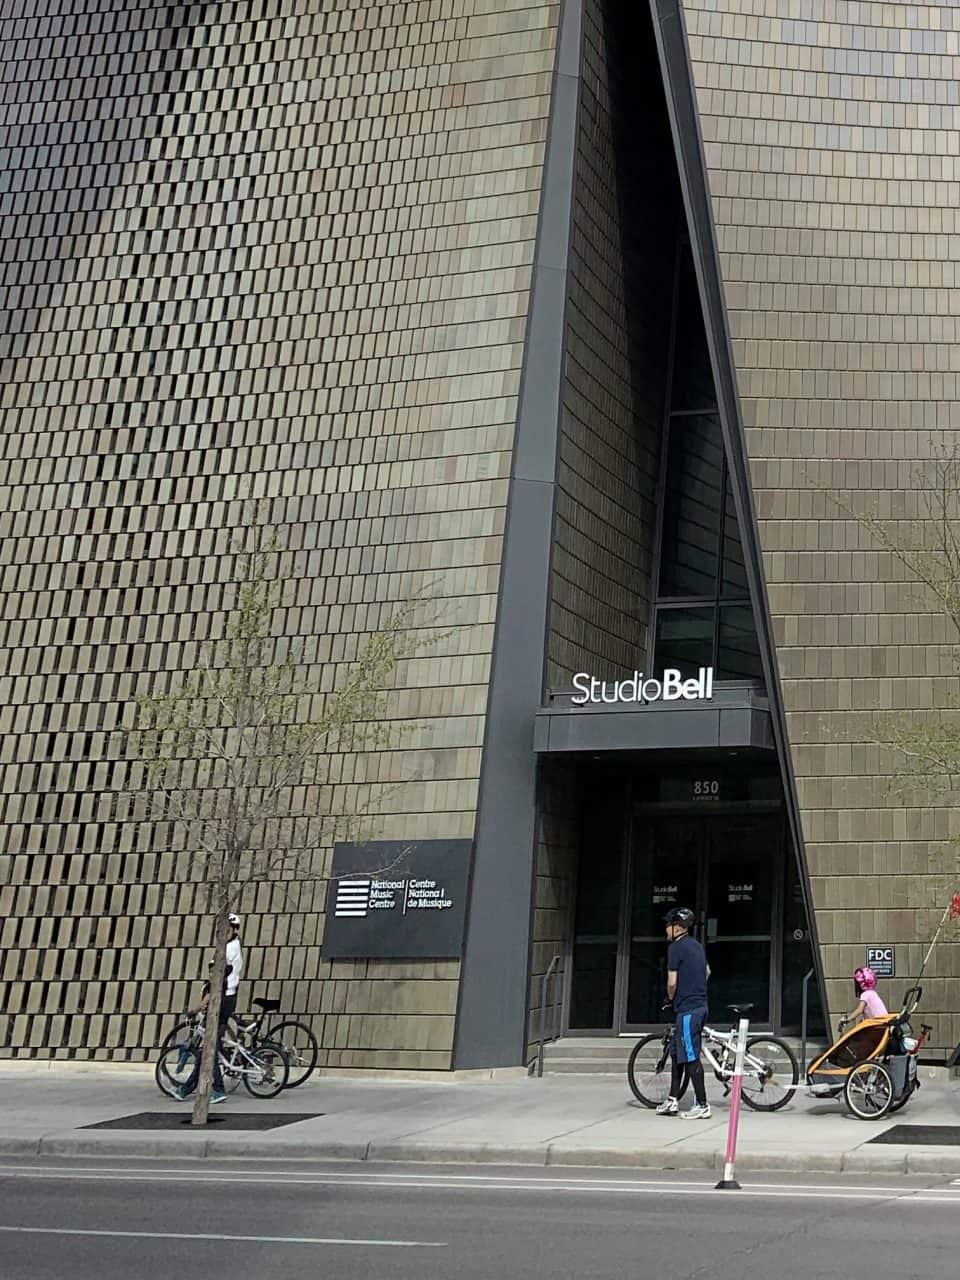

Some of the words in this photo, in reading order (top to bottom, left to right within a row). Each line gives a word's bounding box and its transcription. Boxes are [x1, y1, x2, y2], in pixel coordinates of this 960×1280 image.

[693, 780, 719, 795] 850
[371, 880, 404, 889] National
[409, 880, 436, 888] Centre
[370, 890, 394, 899] Music
[369, 900, 396, 908] Centre
[407, 899, 417, 907] de
[418, 899, 452, 909] Musique
[868, 949, 892, 961] FDC
